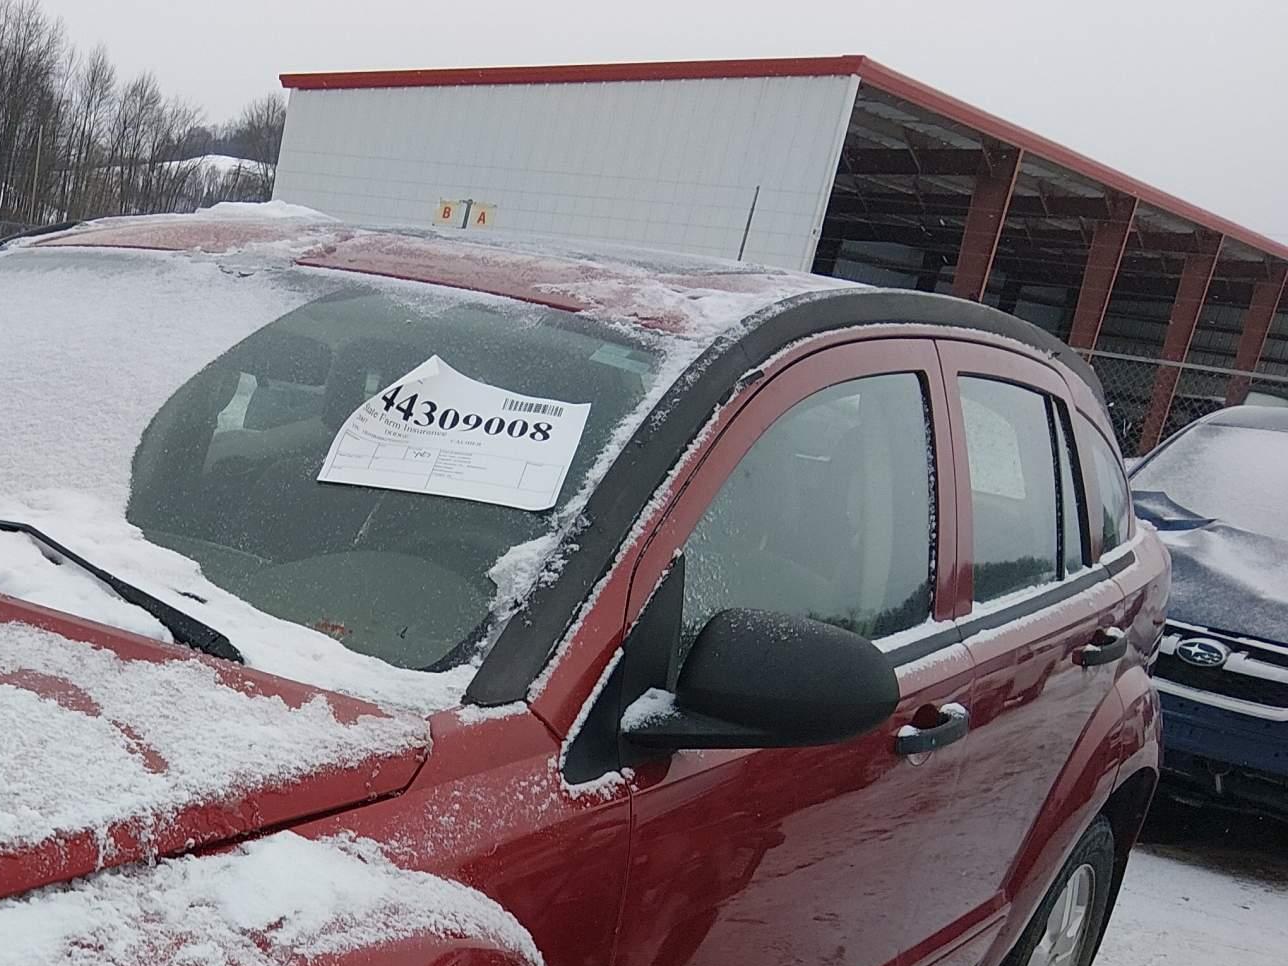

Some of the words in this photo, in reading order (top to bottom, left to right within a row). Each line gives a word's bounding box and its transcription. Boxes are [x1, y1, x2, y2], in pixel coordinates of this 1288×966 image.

[442, 206, 451, 219] B
[477, 211, 486, 224] A
[381, 384, 552, 441] 44309008
[379, 413, 401, 430] Farm
[403, 424, 448, 437] Insurance
